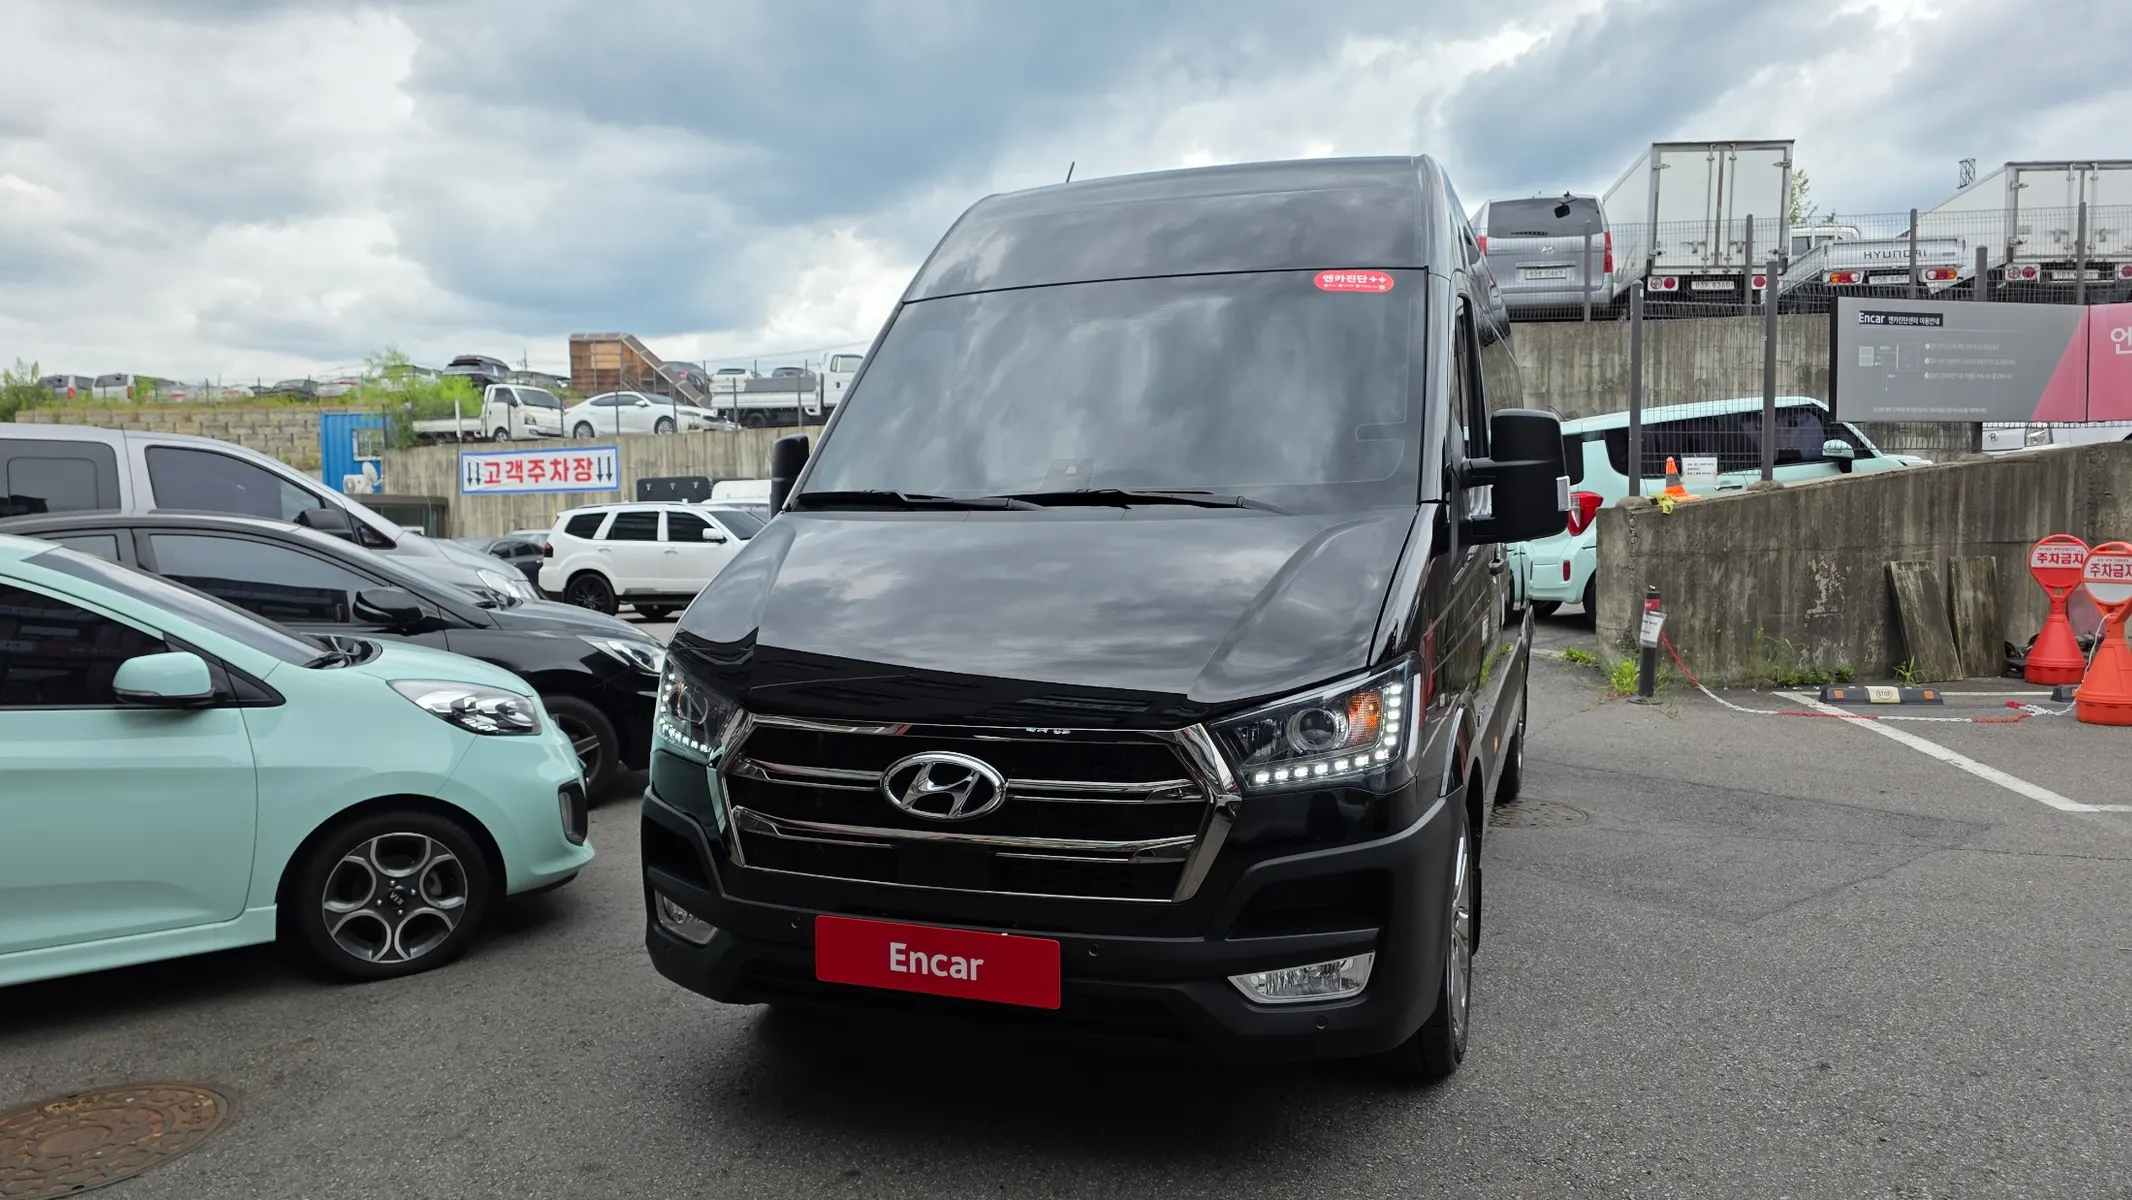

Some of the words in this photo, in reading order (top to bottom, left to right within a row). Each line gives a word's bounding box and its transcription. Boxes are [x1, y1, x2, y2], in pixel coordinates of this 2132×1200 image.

[1863, 249, 1927, 259] HYUNDAI
[1858, 312, 1885, 324] Encar
[483, 457, 594, 485] 고객주차장
[2037, 552, 2084, 565] 주차금지
[889, 942, 984, 981] Encar
